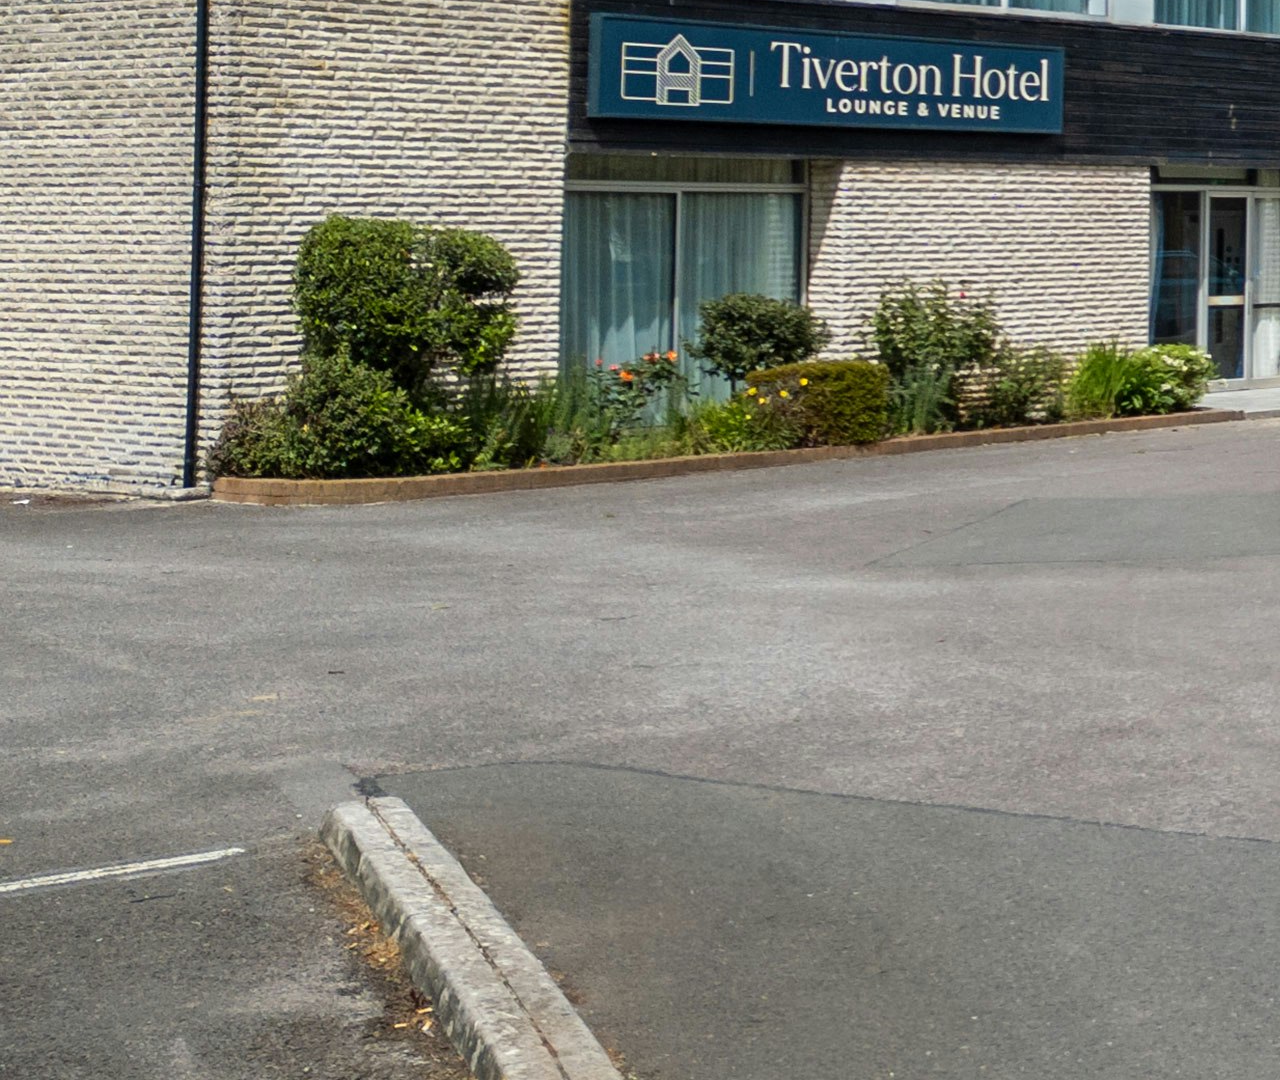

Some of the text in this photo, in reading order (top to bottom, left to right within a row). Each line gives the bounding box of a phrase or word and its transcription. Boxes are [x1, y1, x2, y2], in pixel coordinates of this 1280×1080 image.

[770, 41, 1050, 102] Tiverton Hotel
[826, 98, 1001, 120] LOUNGE & VENUE
